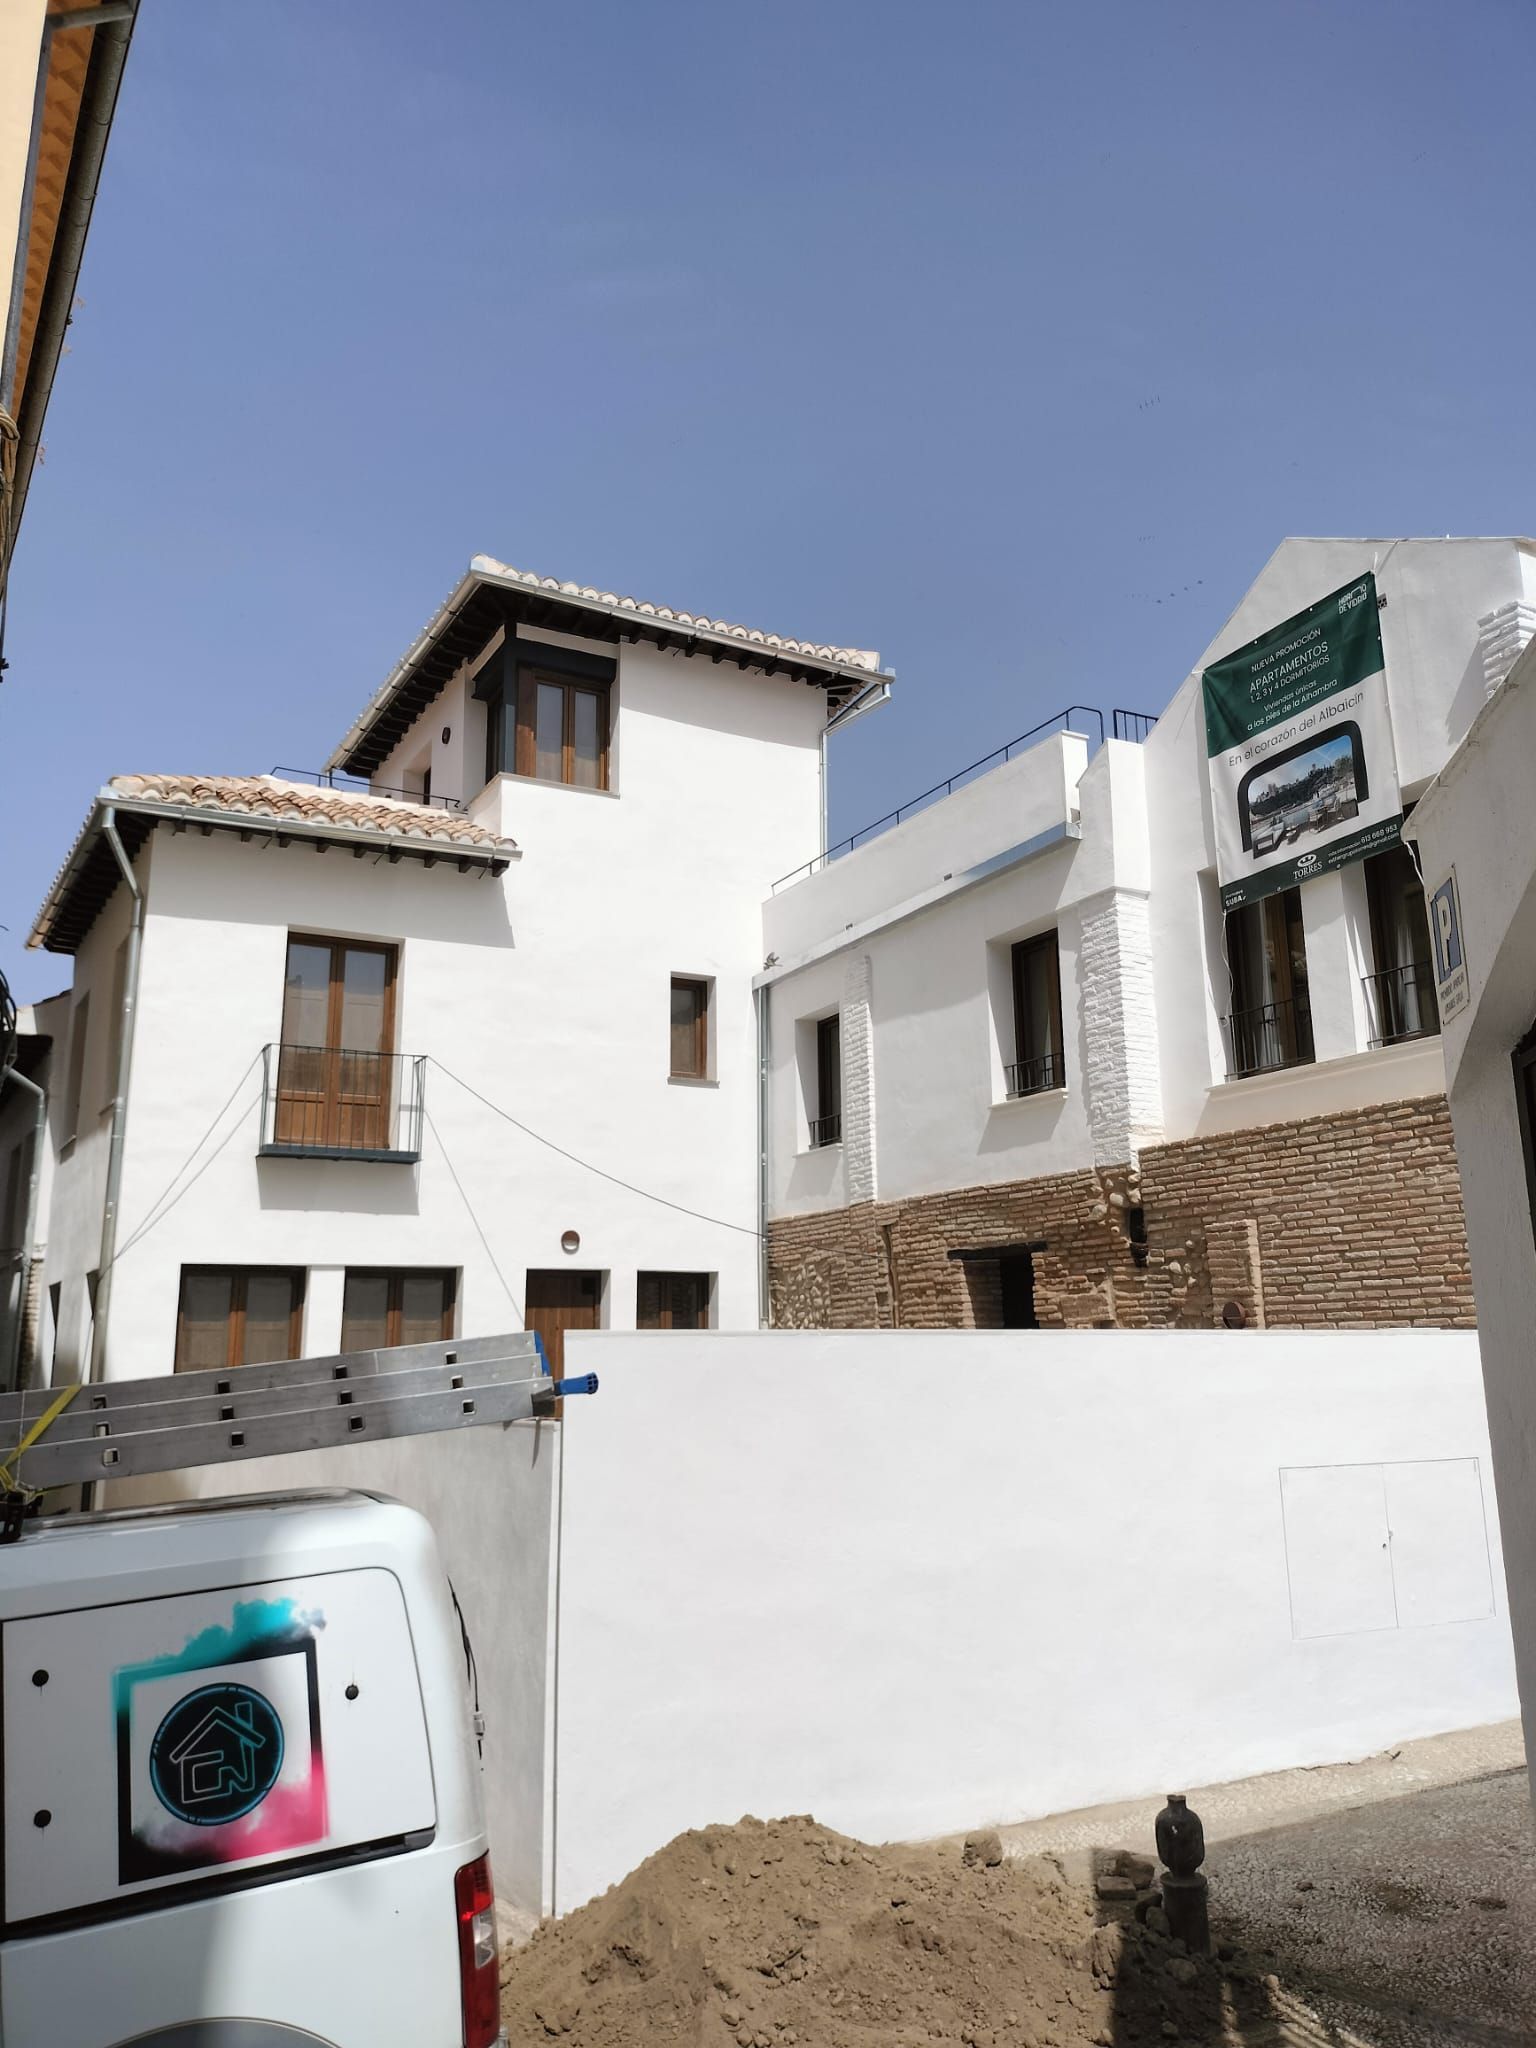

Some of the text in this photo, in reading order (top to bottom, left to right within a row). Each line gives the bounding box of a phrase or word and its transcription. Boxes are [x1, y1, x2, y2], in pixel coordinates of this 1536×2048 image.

[1249, 641, 1329, 692] APARTAMENTOS
[1251, 628, 1321, 673] NUEVA PROMOCIÓN
[1262, 688, 1268, 697] 3
[1267, 686, 1274, 696] y
[1274, 681, 1279, 690] 4
[1280, 654, 1330, 687] DORMITORIOS
[1263, 679, 1317, 712] Viviendas únicas
[1247, 678, 1338, 731] a los pies de la Alhambra
[1228, 691, 1364, 767] En el corazón del Albaicín
[1385, 823, 1398, 834] 953
[1292, 861, 1323, 879] TORRES
[1436, 895, 1453, 972] P
